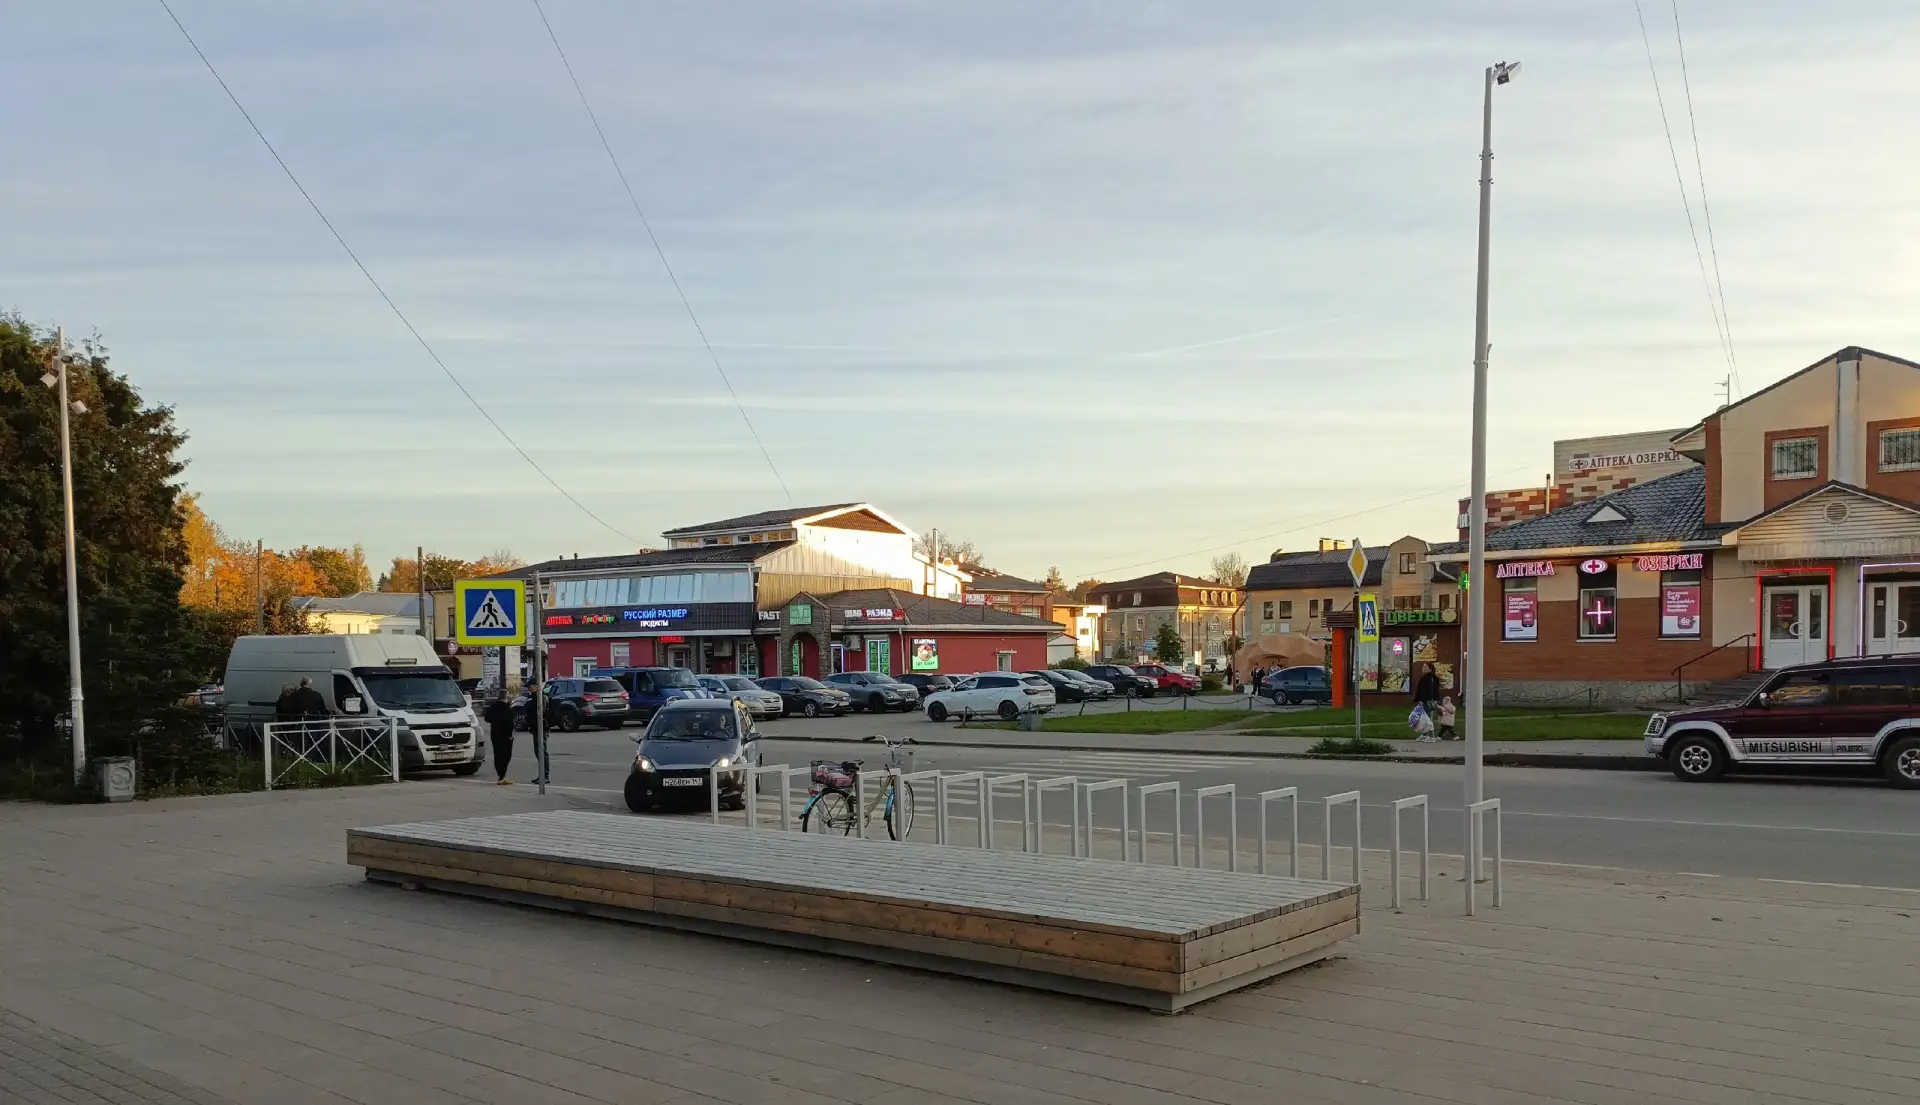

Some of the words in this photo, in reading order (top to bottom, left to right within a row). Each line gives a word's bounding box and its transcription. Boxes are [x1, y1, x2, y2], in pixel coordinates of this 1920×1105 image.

[1590, 454, 1633, 468] АПТЕКА
[1636, 451, 1680, 464] ОЗЕРКИ
[1638, 553, 1703, 571] ОЗЕРКИ
[1496, 560, 1555, 578] АПТЕКА
[624, 608, 657, 620] РУССКИЙ
[658, 608, 688, 619] РАЗМЕР
[758, 611, 781, 621] FAST
[1388, 610, 1440, 625] ЦВЕТЫ
[640, 620, 669, 628] ПРОДУКТЫ
[1749, 741, 1823, 753] MITSUBISHI
